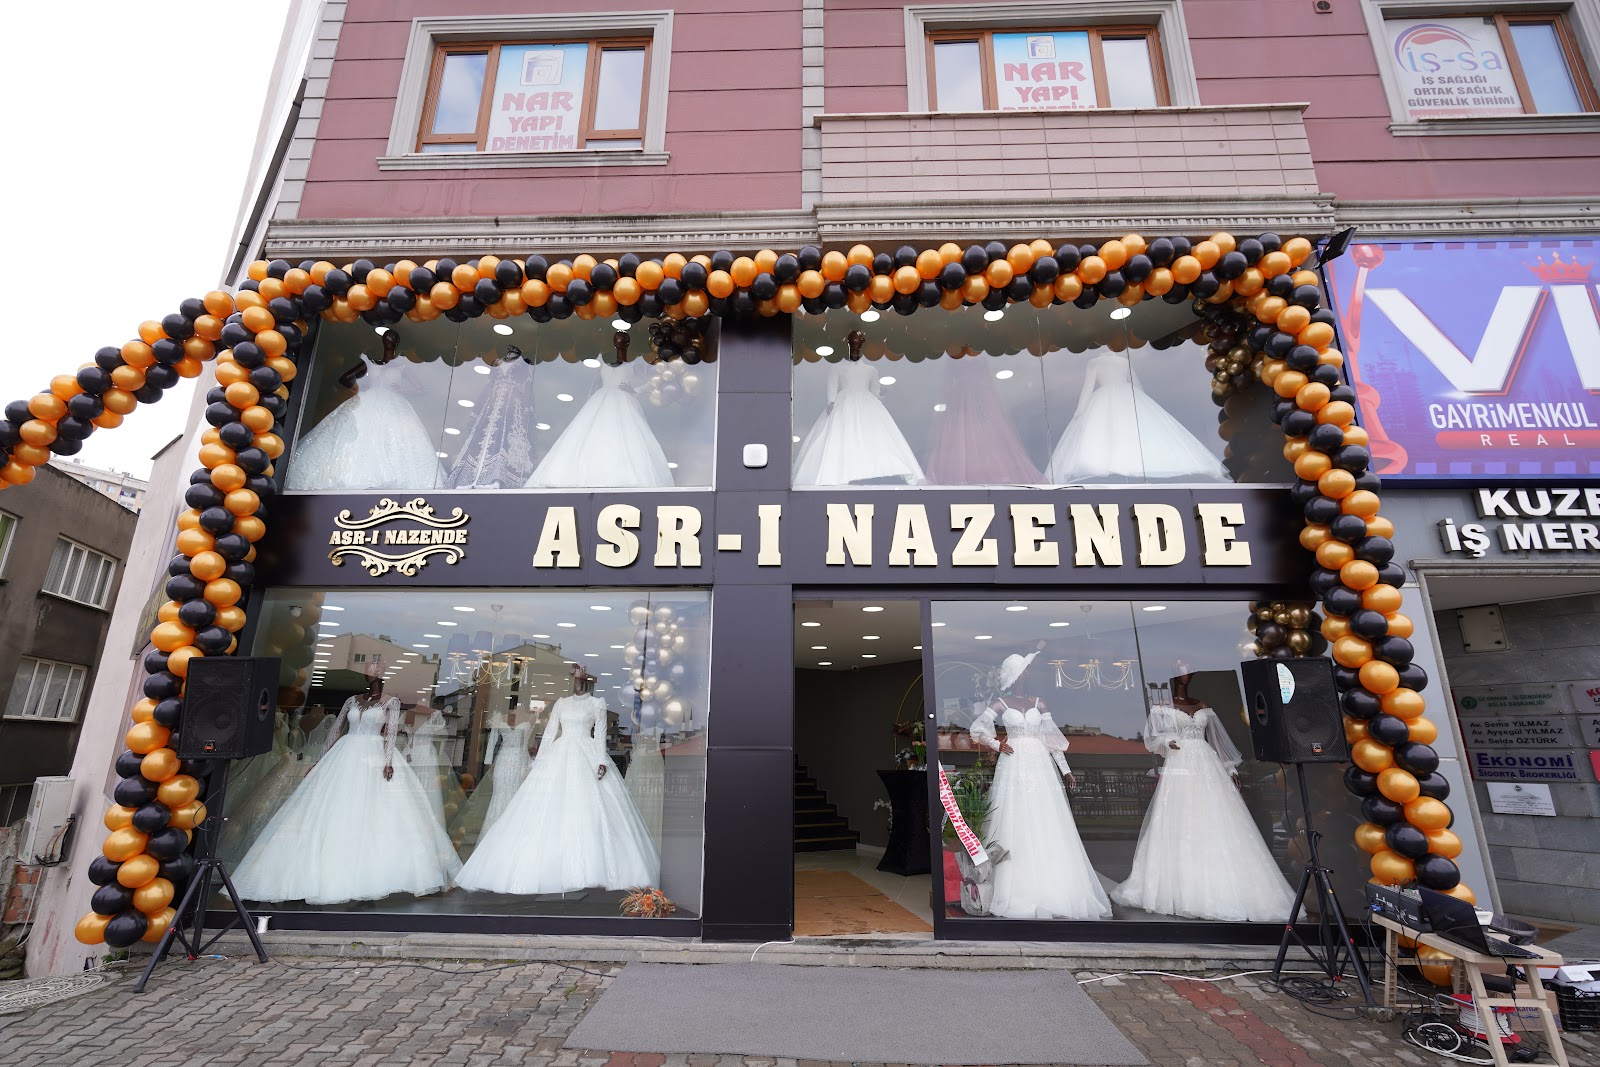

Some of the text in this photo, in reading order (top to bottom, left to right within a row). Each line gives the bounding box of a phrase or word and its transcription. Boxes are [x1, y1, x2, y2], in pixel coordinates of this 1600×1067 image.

[1003, 61, 1088, 83] NAR
[1421, 74, 1488, 86] İŞ SAĞLIĞI
[1015, 85, 1079, 103] YAPI
[1413, 84, 1503, 96] ORTAK SAĞLIK
[501, 91, 575, 113] NAR
[1407, 95, 1516, 107] GÜVENLİK BİRİMİ
[507, 115, 564, 134] YAPI
[491, 131, 575, 152] DENETİM
[1364, 284, 1600, 391] VI
[1480, 433, 1576, 446] REAL
[329, 529, 468, 545] ASR-I NAZENDE
[825, 503, 1252, 567] NAZENDE
[1445, 517, 1600, 558] İŞ MER
[1487, 728, 1523, 736] Ayşegül
